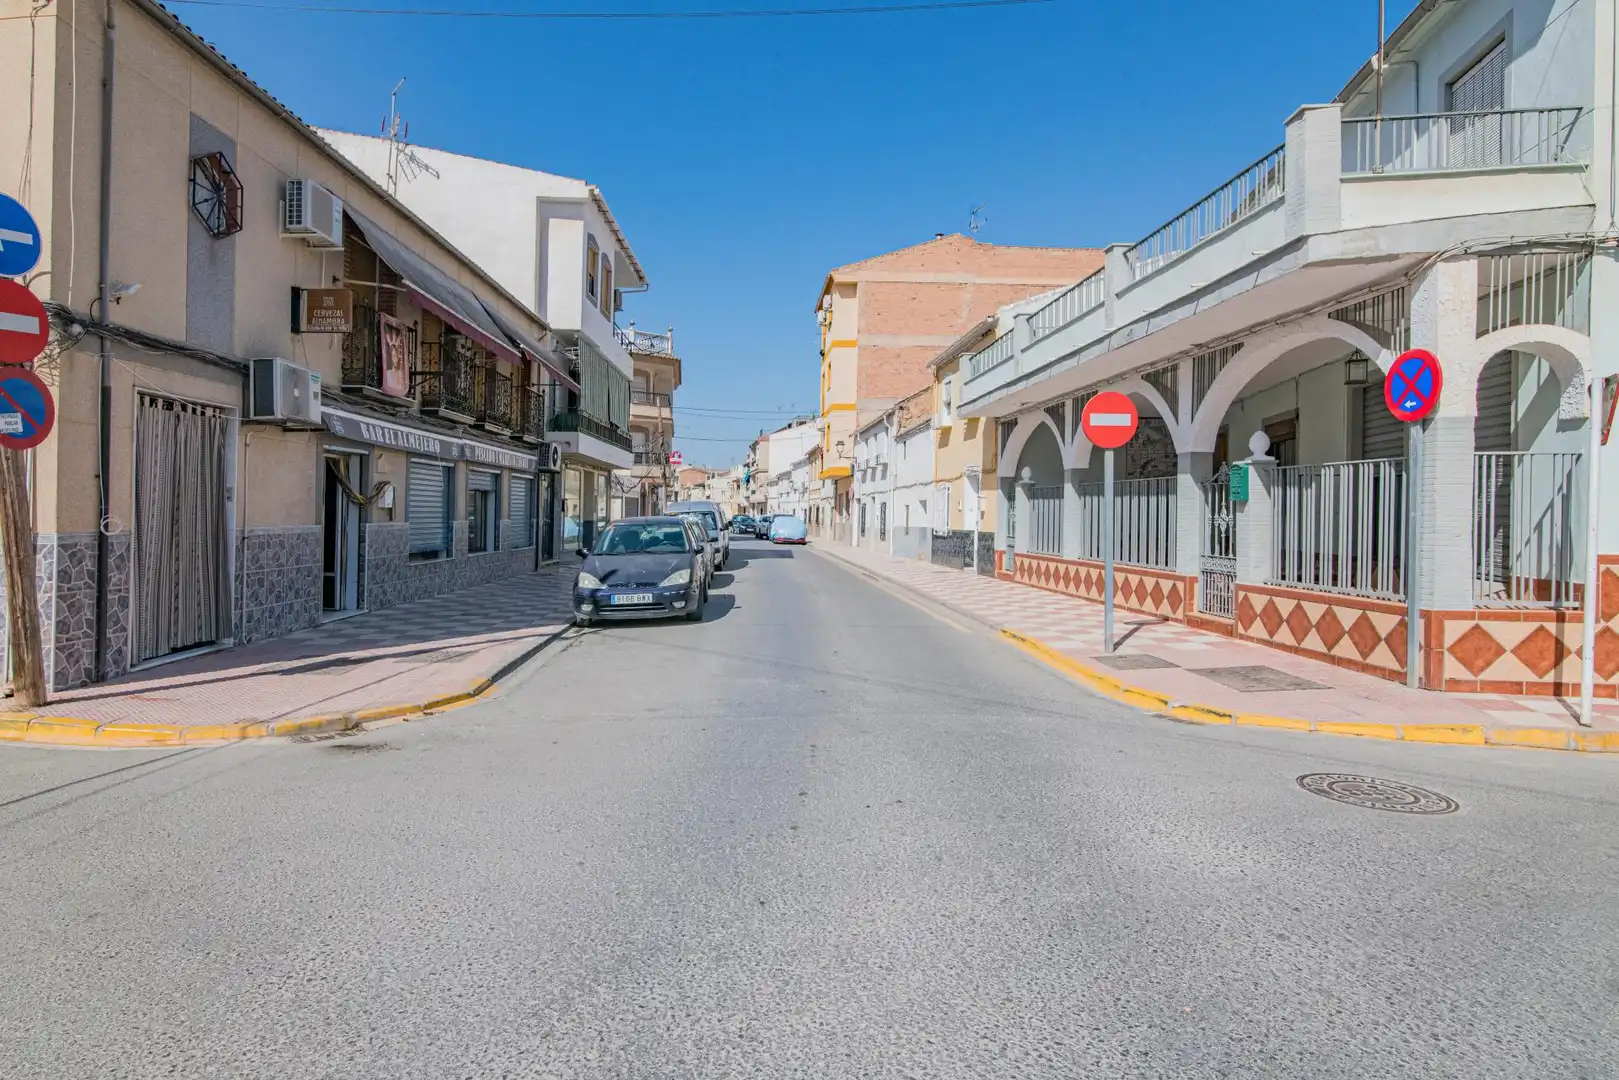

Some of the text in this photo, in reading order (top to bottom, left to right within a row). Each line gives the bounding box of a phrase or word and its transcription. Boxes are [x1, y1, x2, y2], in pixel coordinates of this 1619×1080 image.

[313, 309, 344, 317] CERVEZAS
[311, 317, 345, 325] ALHAMBRA
[360, 422, 384, 441] BAR
[384, 428, 397, 445] EL
